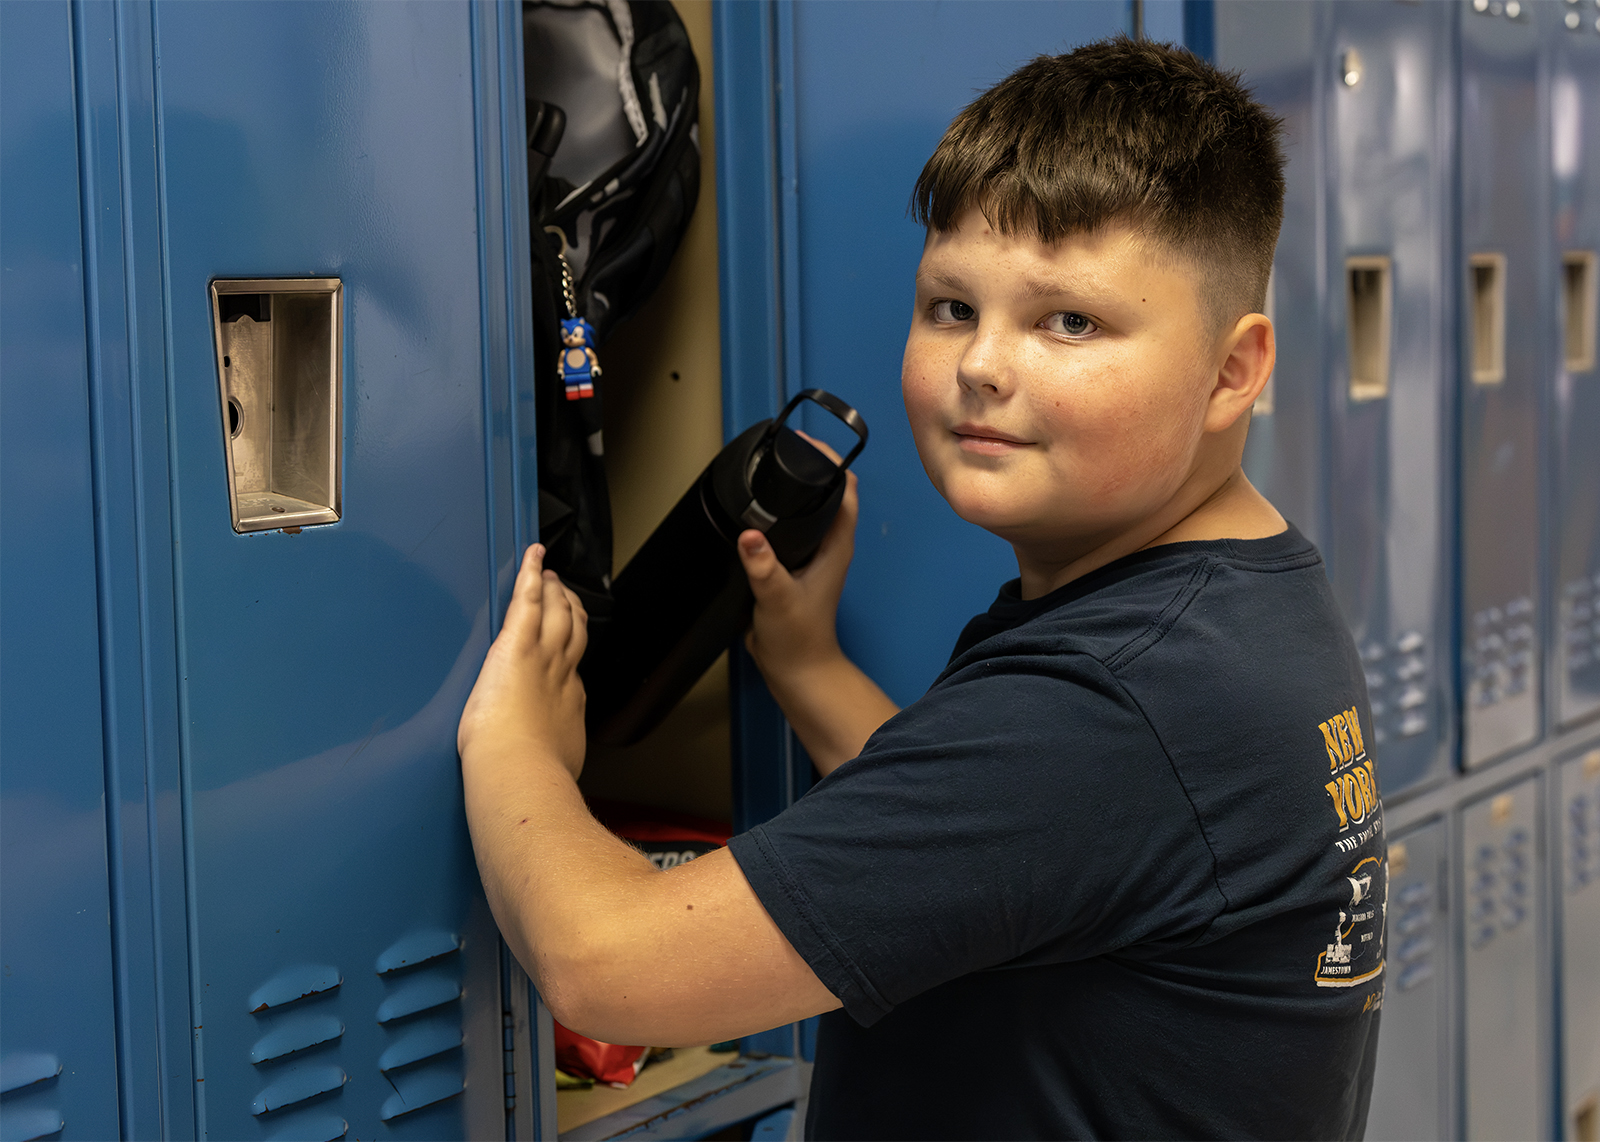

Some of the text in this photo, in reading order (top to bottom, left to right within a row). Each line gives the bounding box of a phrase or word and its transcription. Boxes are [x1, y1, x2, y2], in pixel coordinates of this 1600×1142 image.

[1318, 706, 1366, 775] NEW
[1325, 759, 1379, 833] YORK
[1335, 836, 1358, 852] THE
